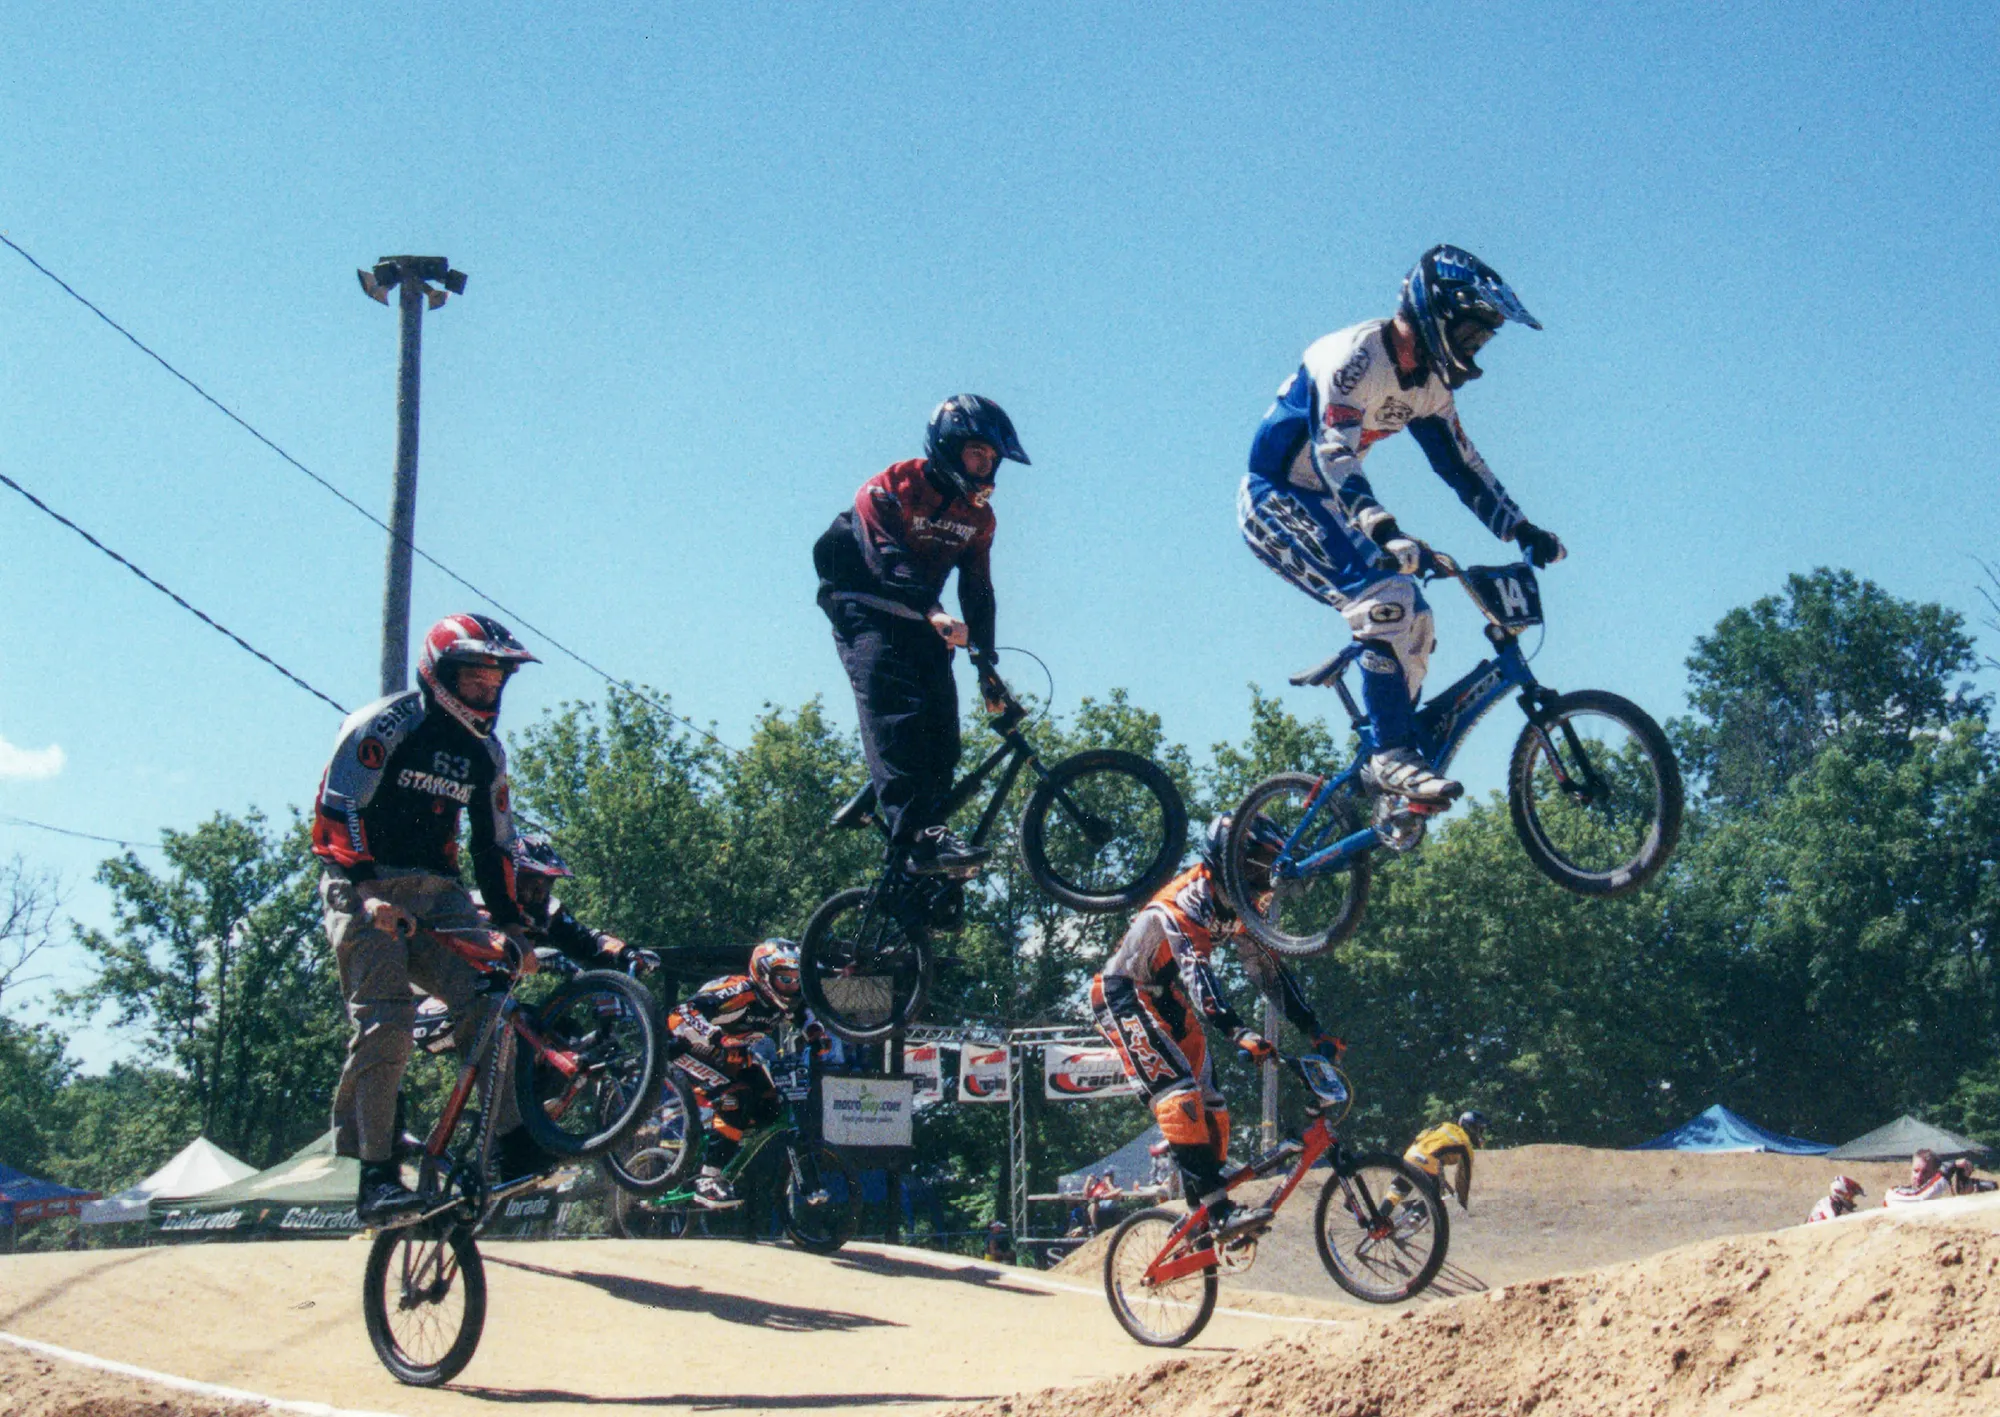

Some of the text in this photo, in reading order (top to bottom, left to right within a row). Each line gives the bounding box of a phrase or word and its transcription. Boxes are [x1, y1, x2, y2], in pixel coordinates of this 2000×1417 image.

[1494, 577, 1529, 617] 14
[432, 751, 471, 779] 63
[1120, 1014, 1178, 1081] FOX
[674, 1053, 731, 1087] SHIFT
[160, 1208, 243, 1230] Gatorade
[280, 1206, 365, 1229] Gatorad
